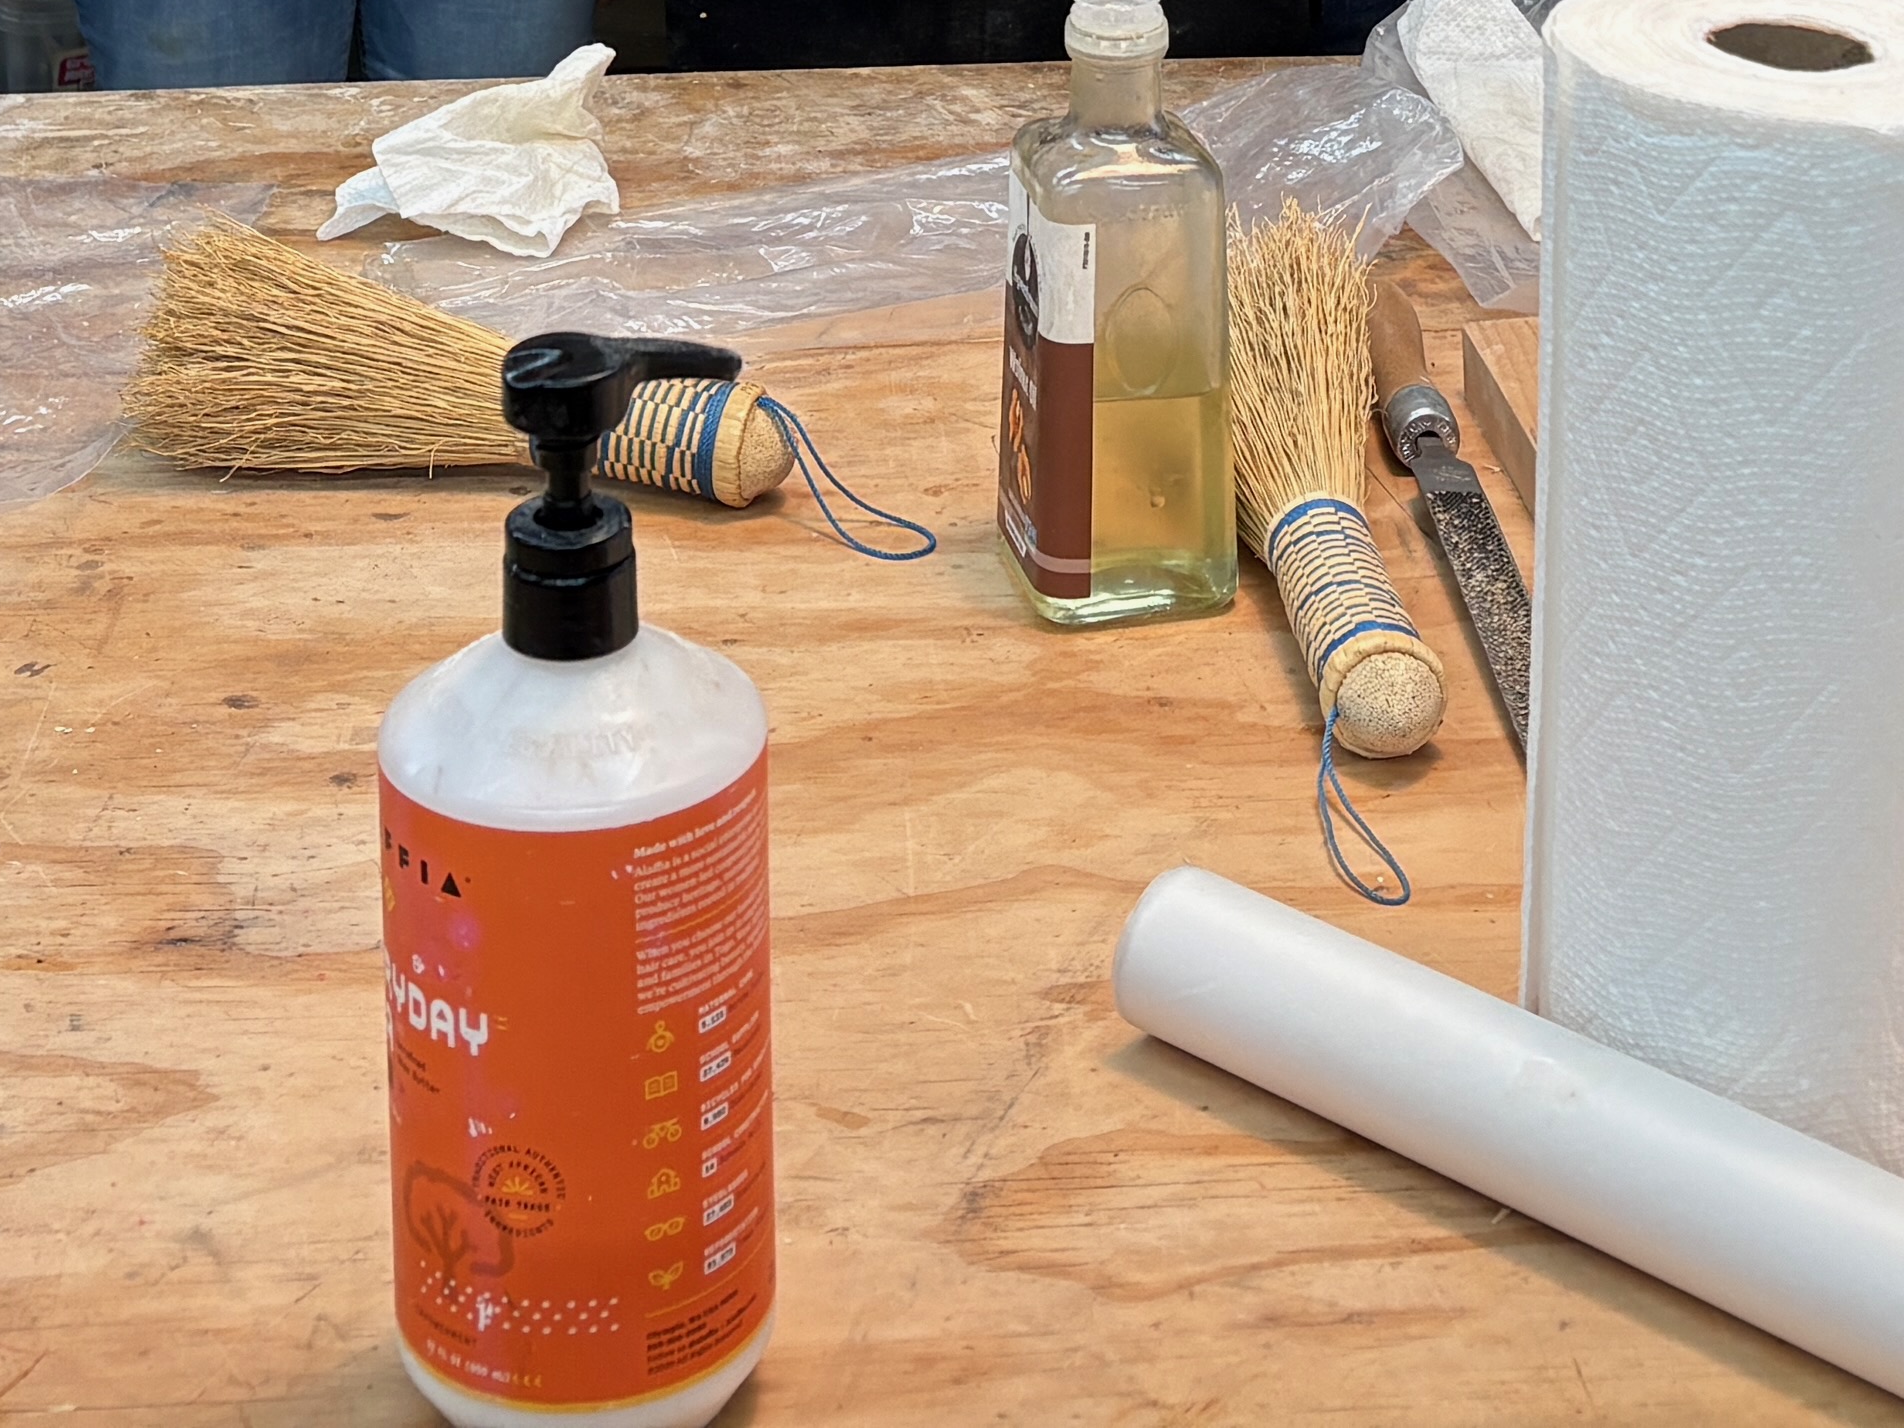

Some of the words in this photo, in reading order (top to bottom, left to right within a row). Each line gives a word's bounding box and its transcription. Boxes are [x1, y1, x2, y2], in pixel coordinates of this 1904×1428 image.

[634, 842, 667, 858] Made
[668, 831, 694, 848] with
[694, 822, 715, 839] love
[716, 810, 732, 828] and
[634, 860, 671, 877] Alaffia
[672, 855, 682, 868] is
[634, 875, 669, 891] create
[634, 891, 656, 905] Our
[635, 945, 670, 961] When
[670, 937, 691, 953] you
[636, 960, 659, 976] hair
[637, 974, 659, 989] and
[660, 960, 702, 982] families
